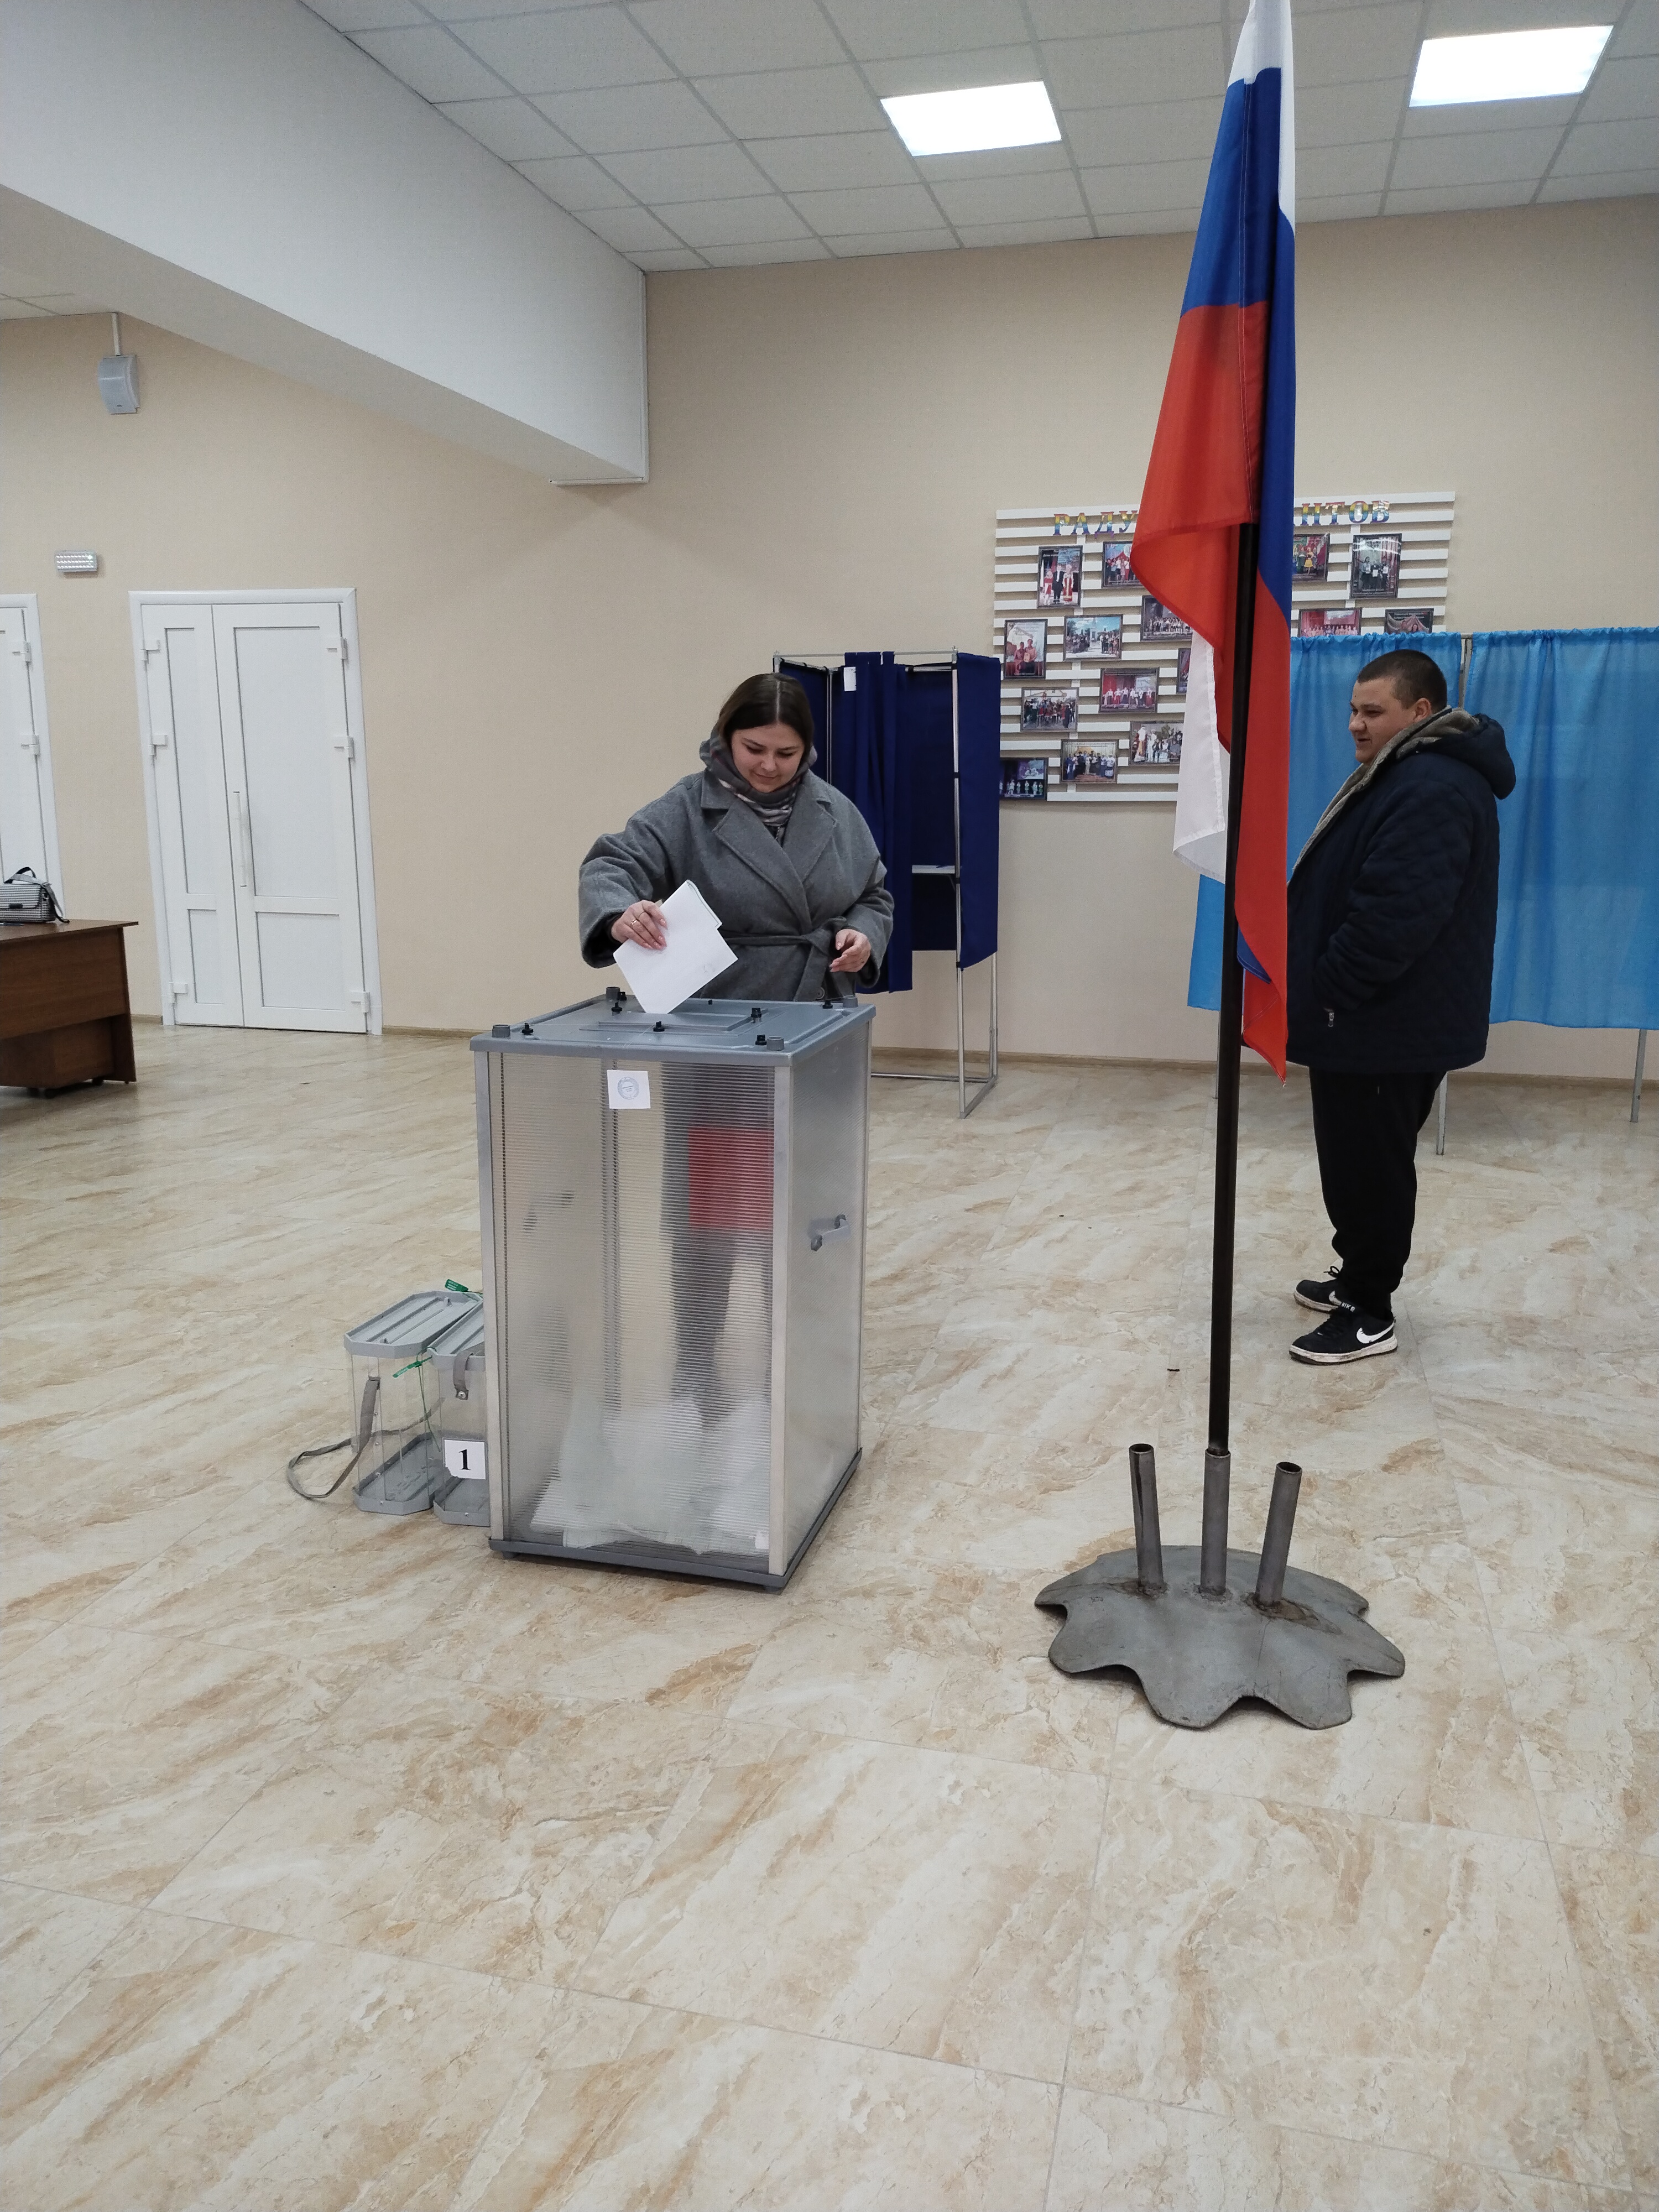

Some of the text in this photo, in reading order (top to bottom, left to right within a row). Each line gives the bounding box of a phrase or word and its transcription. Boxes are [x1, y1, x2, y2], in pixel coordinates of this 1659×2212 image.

[1053, 500, 1390, 539] РАДУ НТОВ
[1341, 1302, 1355, 1312] NIKE
[458, 1449, 471, 1470] 1
